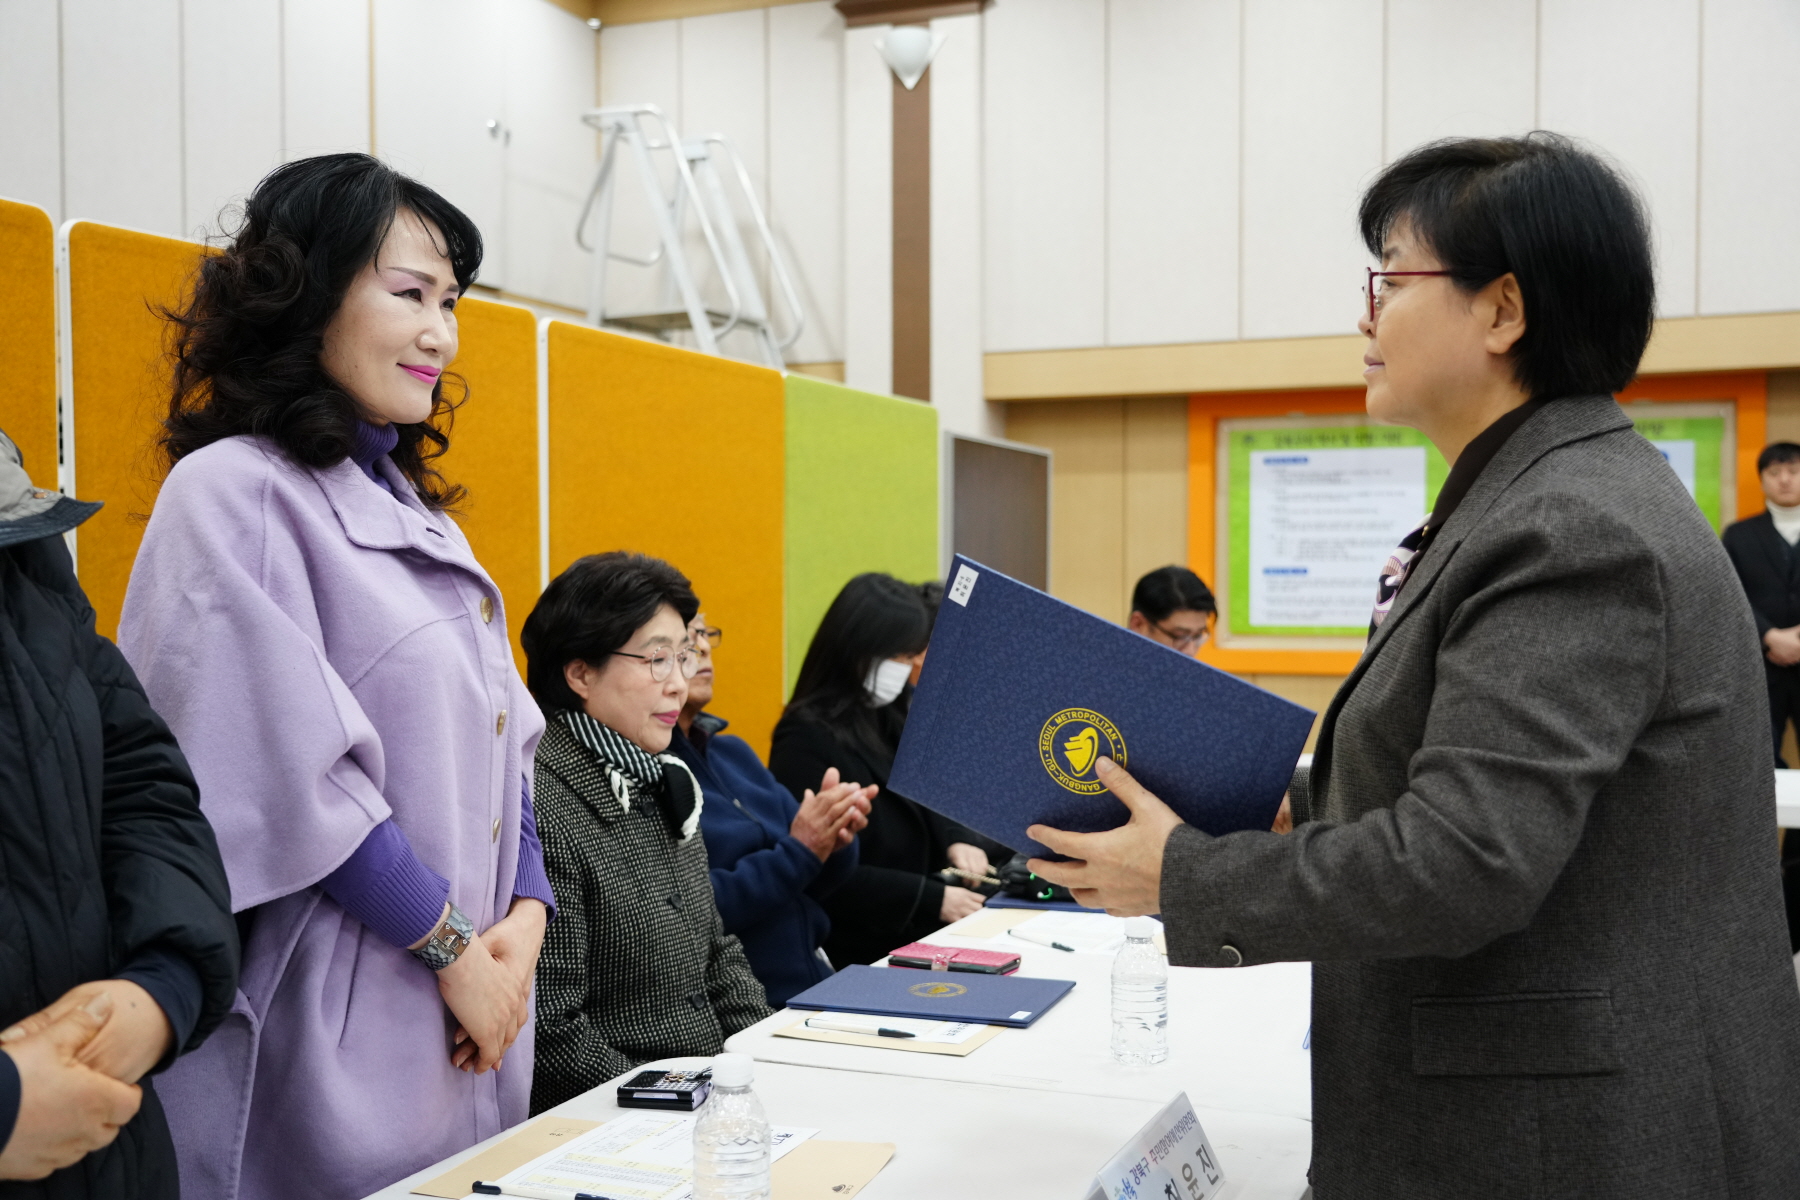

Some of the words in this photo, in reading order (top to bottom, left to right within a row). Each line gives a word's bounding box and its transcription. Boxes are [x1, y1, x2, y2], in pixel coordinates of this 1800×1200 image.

[1042, 725, 1056, 751] SEOUL
[1054, 711, 1119, 740] METROPOLITAN
[1045, 759, 1101, 792] GANGBUK-GU
[1129, 1156, 1151, 1185] 강북구
[1149, 1110, 1197, 1165] 주민참여예산위원회
